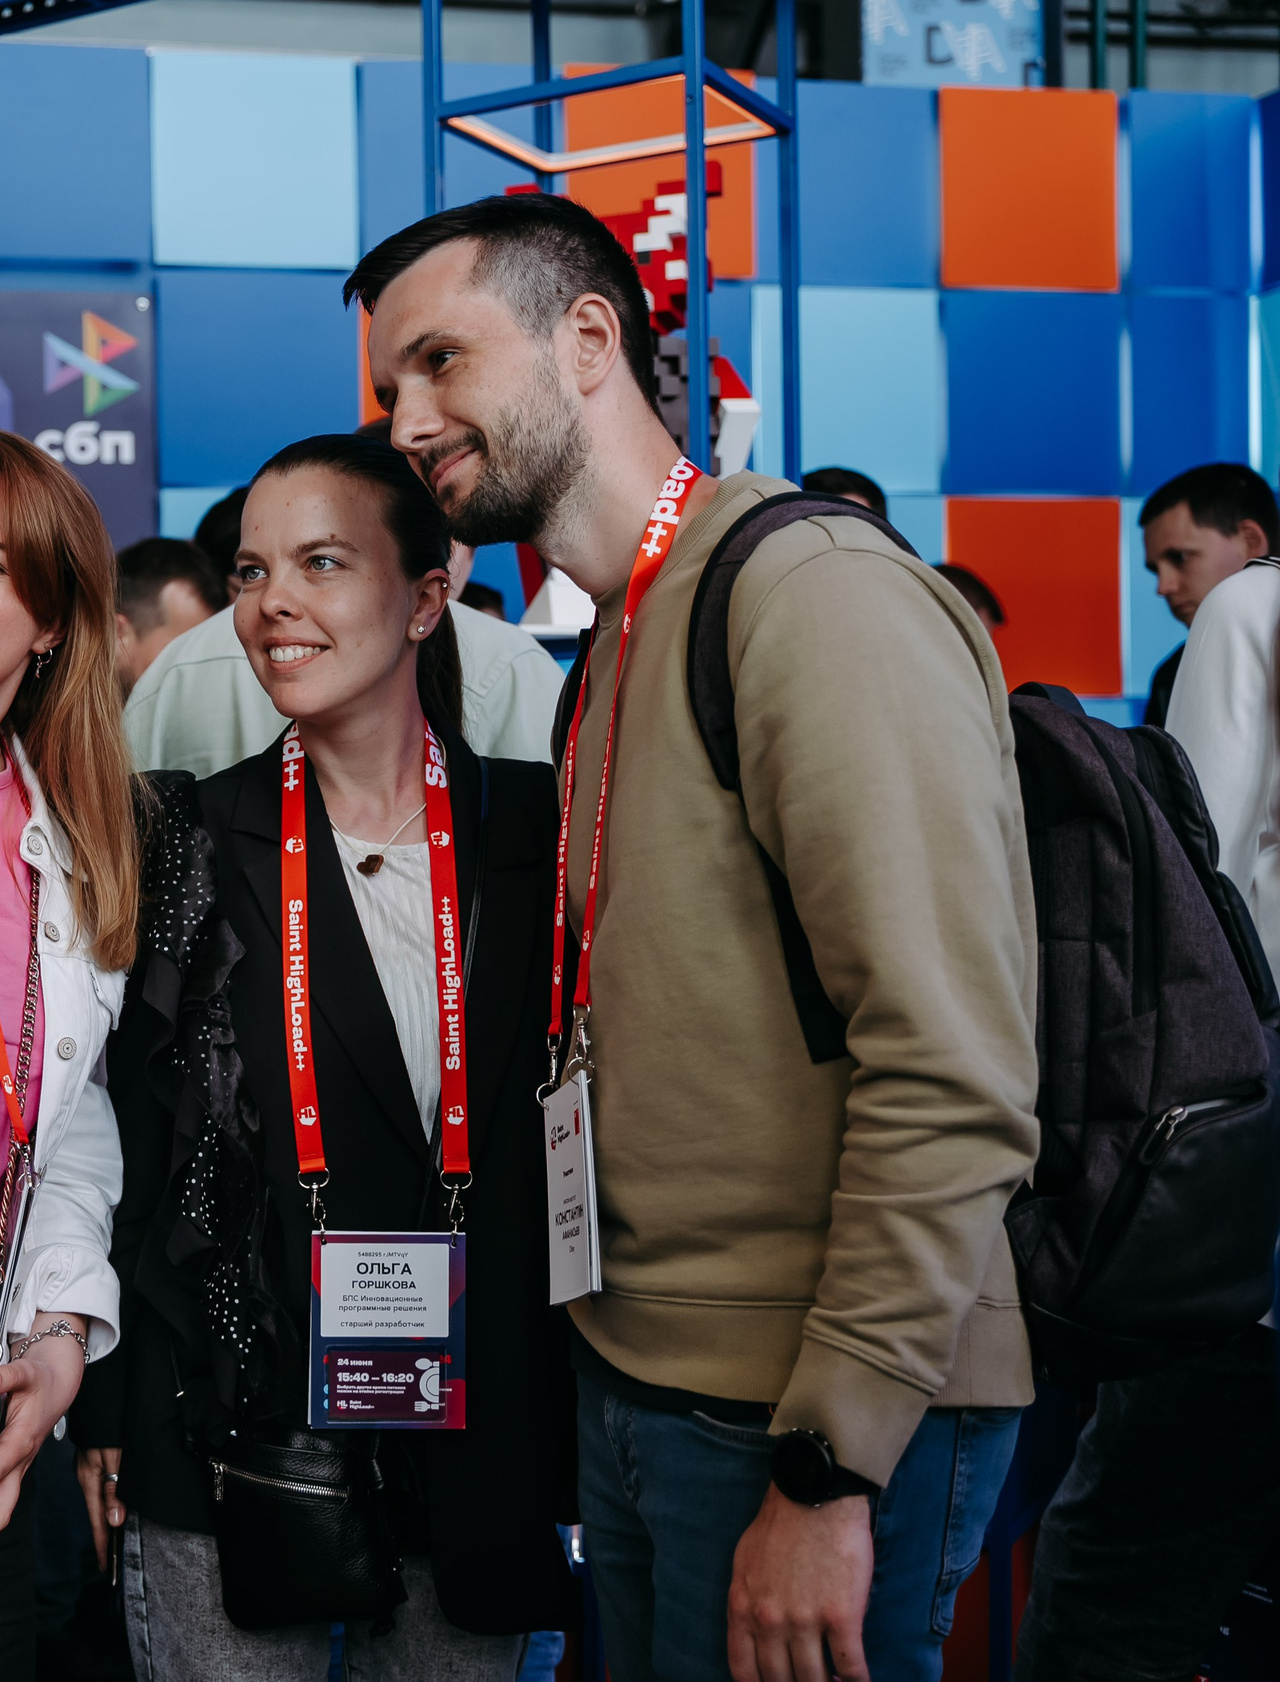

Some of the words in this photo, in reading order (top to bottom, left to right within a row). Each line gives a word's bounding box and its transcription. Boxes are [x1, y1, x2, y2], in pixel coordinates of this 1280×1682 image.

[33, 421, 137, 466] сбп
[288, 899, 303, 952] Saint
[438, 896, 461, 1010] HighLoad++
[286, 954, 307, 1072] HighLoad++
[445, 1013, 460, 1071] Saint
[356, 1262, 412, 1275] ОЛЬГА
[351, 1280, 416, 1289] ГОРШКОВА
[360, 1295, 423, 1304] Инновационные
[375, 1320, 425, 1328] разработчик
[337, 1358, 349, 1366] 24
[337, 1372, 370, 1383] 15:40
[381, 1373, 414, 1383] 16:20
